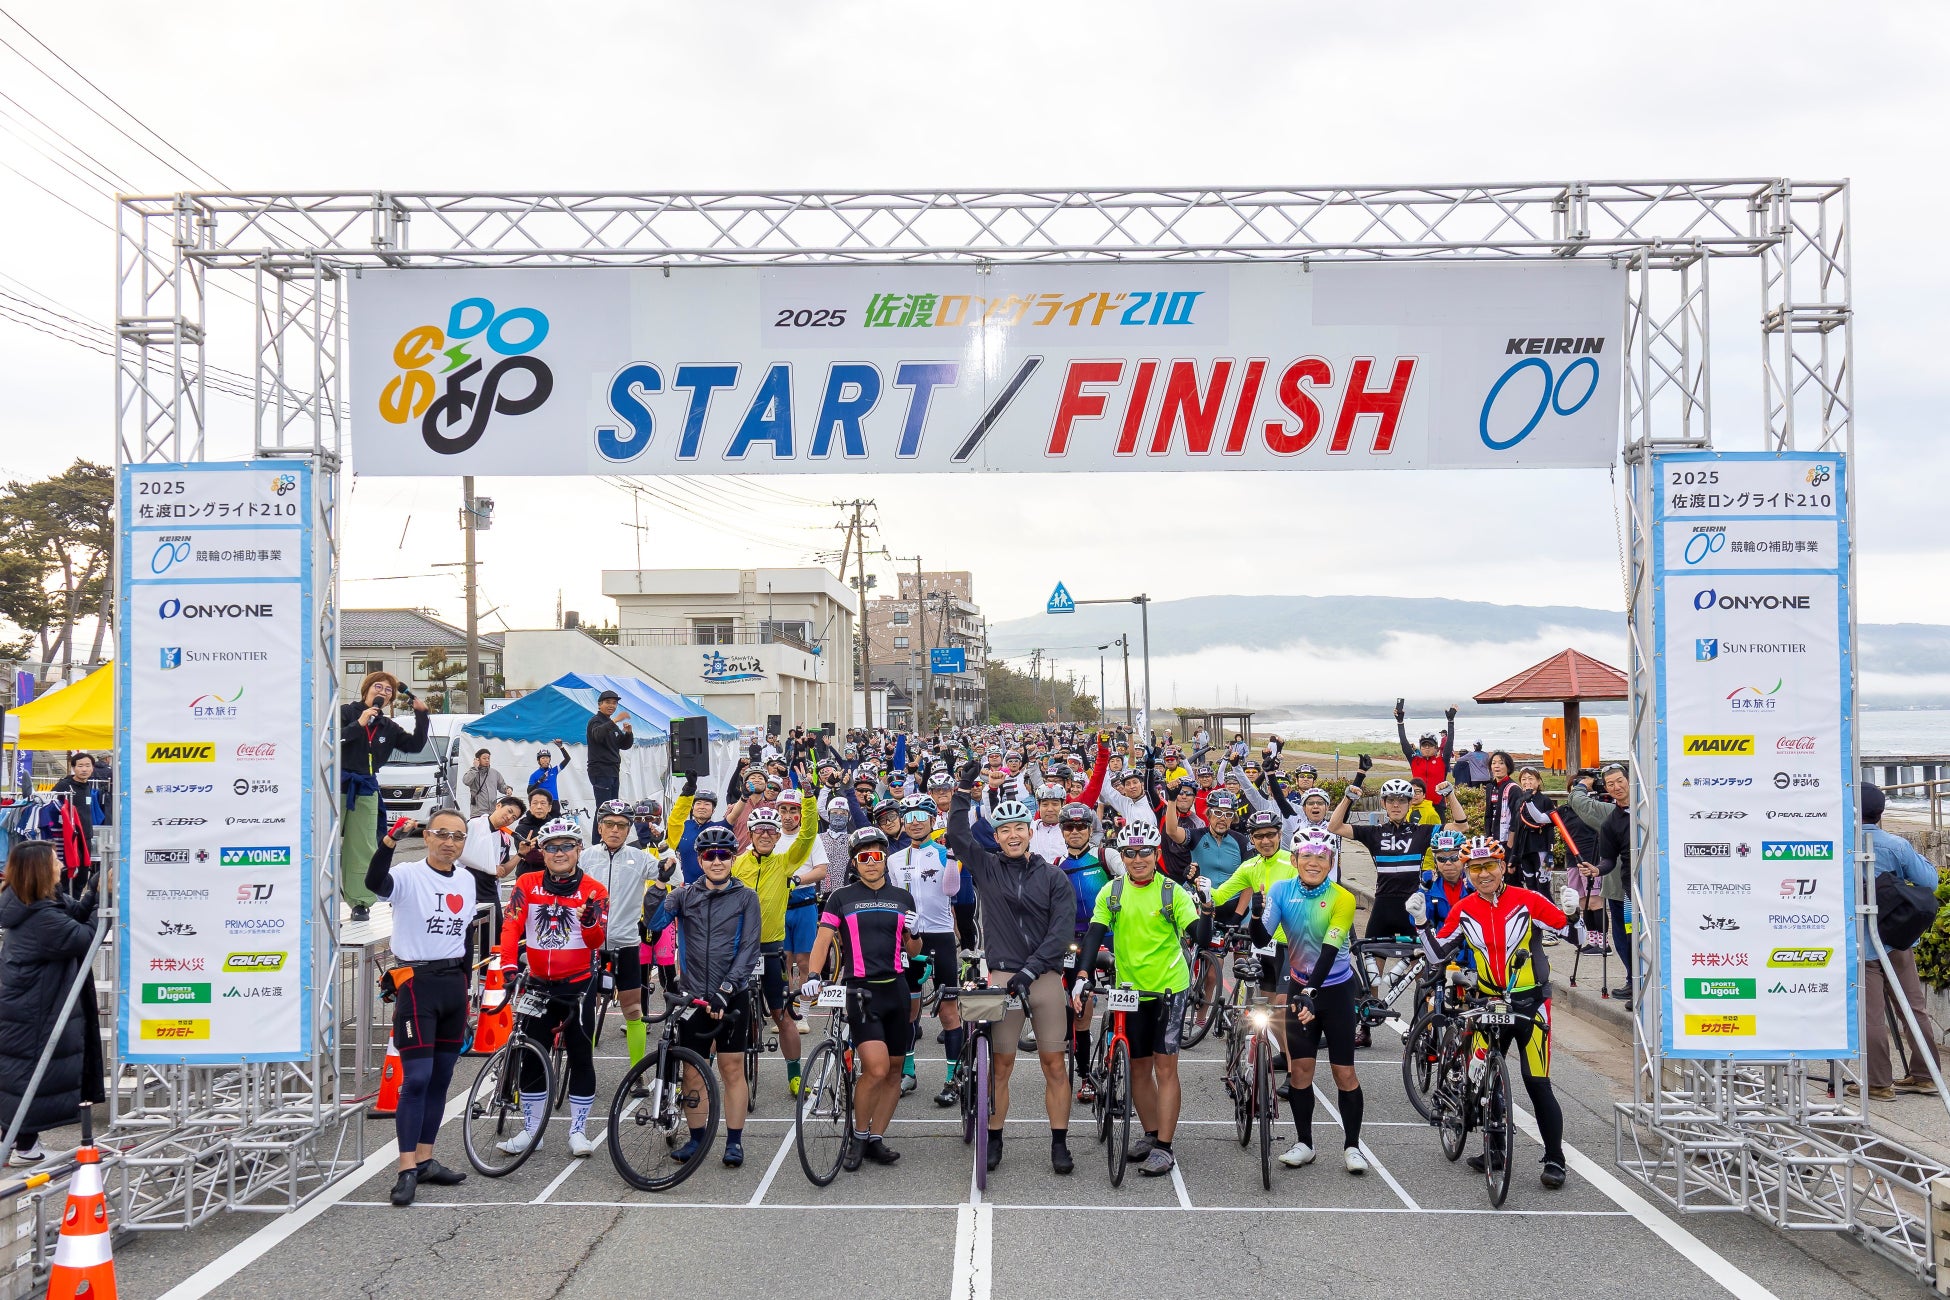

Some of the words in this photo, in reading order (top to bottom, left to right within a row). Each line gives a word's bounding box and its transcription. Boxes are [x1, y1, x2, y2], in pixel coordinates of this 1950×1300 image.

[774, 309, 847, 327] 2025
[1505, 338, 1605, 355] KEIRIN
[594, 361, 963, 463] START
[1043, 354, 1420, 458] FINISH
[1672, 472, 1719, 485] 2025
[140, 482, 185, 494] 2025
[1672, 493, 1831, 509] 佐渡ロングライド210
[139, 502, 296, 518] 佐渡ロングライド210
[1731, 540, 1818, 552] 競輪の補助事業
[196, 550, 282, 562] 競輪の補助事業
[1723, 642, 1747, 653] SUN
[1749, 643, 1806, 653] FRONTIER
[186, 650, 210, 662] SUN
[212, 651, 267, 661] FRONTIER
[1732, 699, 1775, 708] 日本旅行
[194, 706, 237, 716] 日本旅行
[1688, 740, 1750, 751] MAVIC
[151, 747, 211, 759] MAVIC
[1694, 777, 1752, 786] 新潟メンテック
[156, 784, 213, 793] 新潟メンテック
[148, 851, 187, 861] Muc-Off
[247, 850, 286, 862] YONEX
[1687, 846, 1728, 856] Muc-Off
[1790, 845, 1829, 857] YONEX
[237, 884, 274, 901] STJ
[1780, 879, 1817, 896] STJ
[435, 893, 444, 912] I
[225, 920, 255, 929] PRIMO
[256, 919, 285, 928] SADO
[1769, 915, 1800, 923] PRIMO
[1802, 914, 1829, 923] SADO
[426, 916, 463, 936] 佐渡
[228, 955, 282, 966] GALFER
[1692, 953, 1749, 967] 共栄火災
[1773, 950, 1827, 962] GALFER
[150, 958, 205, 971] 共栄火災
[157, 986, 196, 1001] Dugout
[1701, 982, 1740, 996] Dugout
[1113, 994, 1135, 1004] 1246
[1486, 1014, 1511, 1024] 1358
[156, 1027, 194, 1037] サカモト
[1701, 1023, 1740, 1033] サカモト
